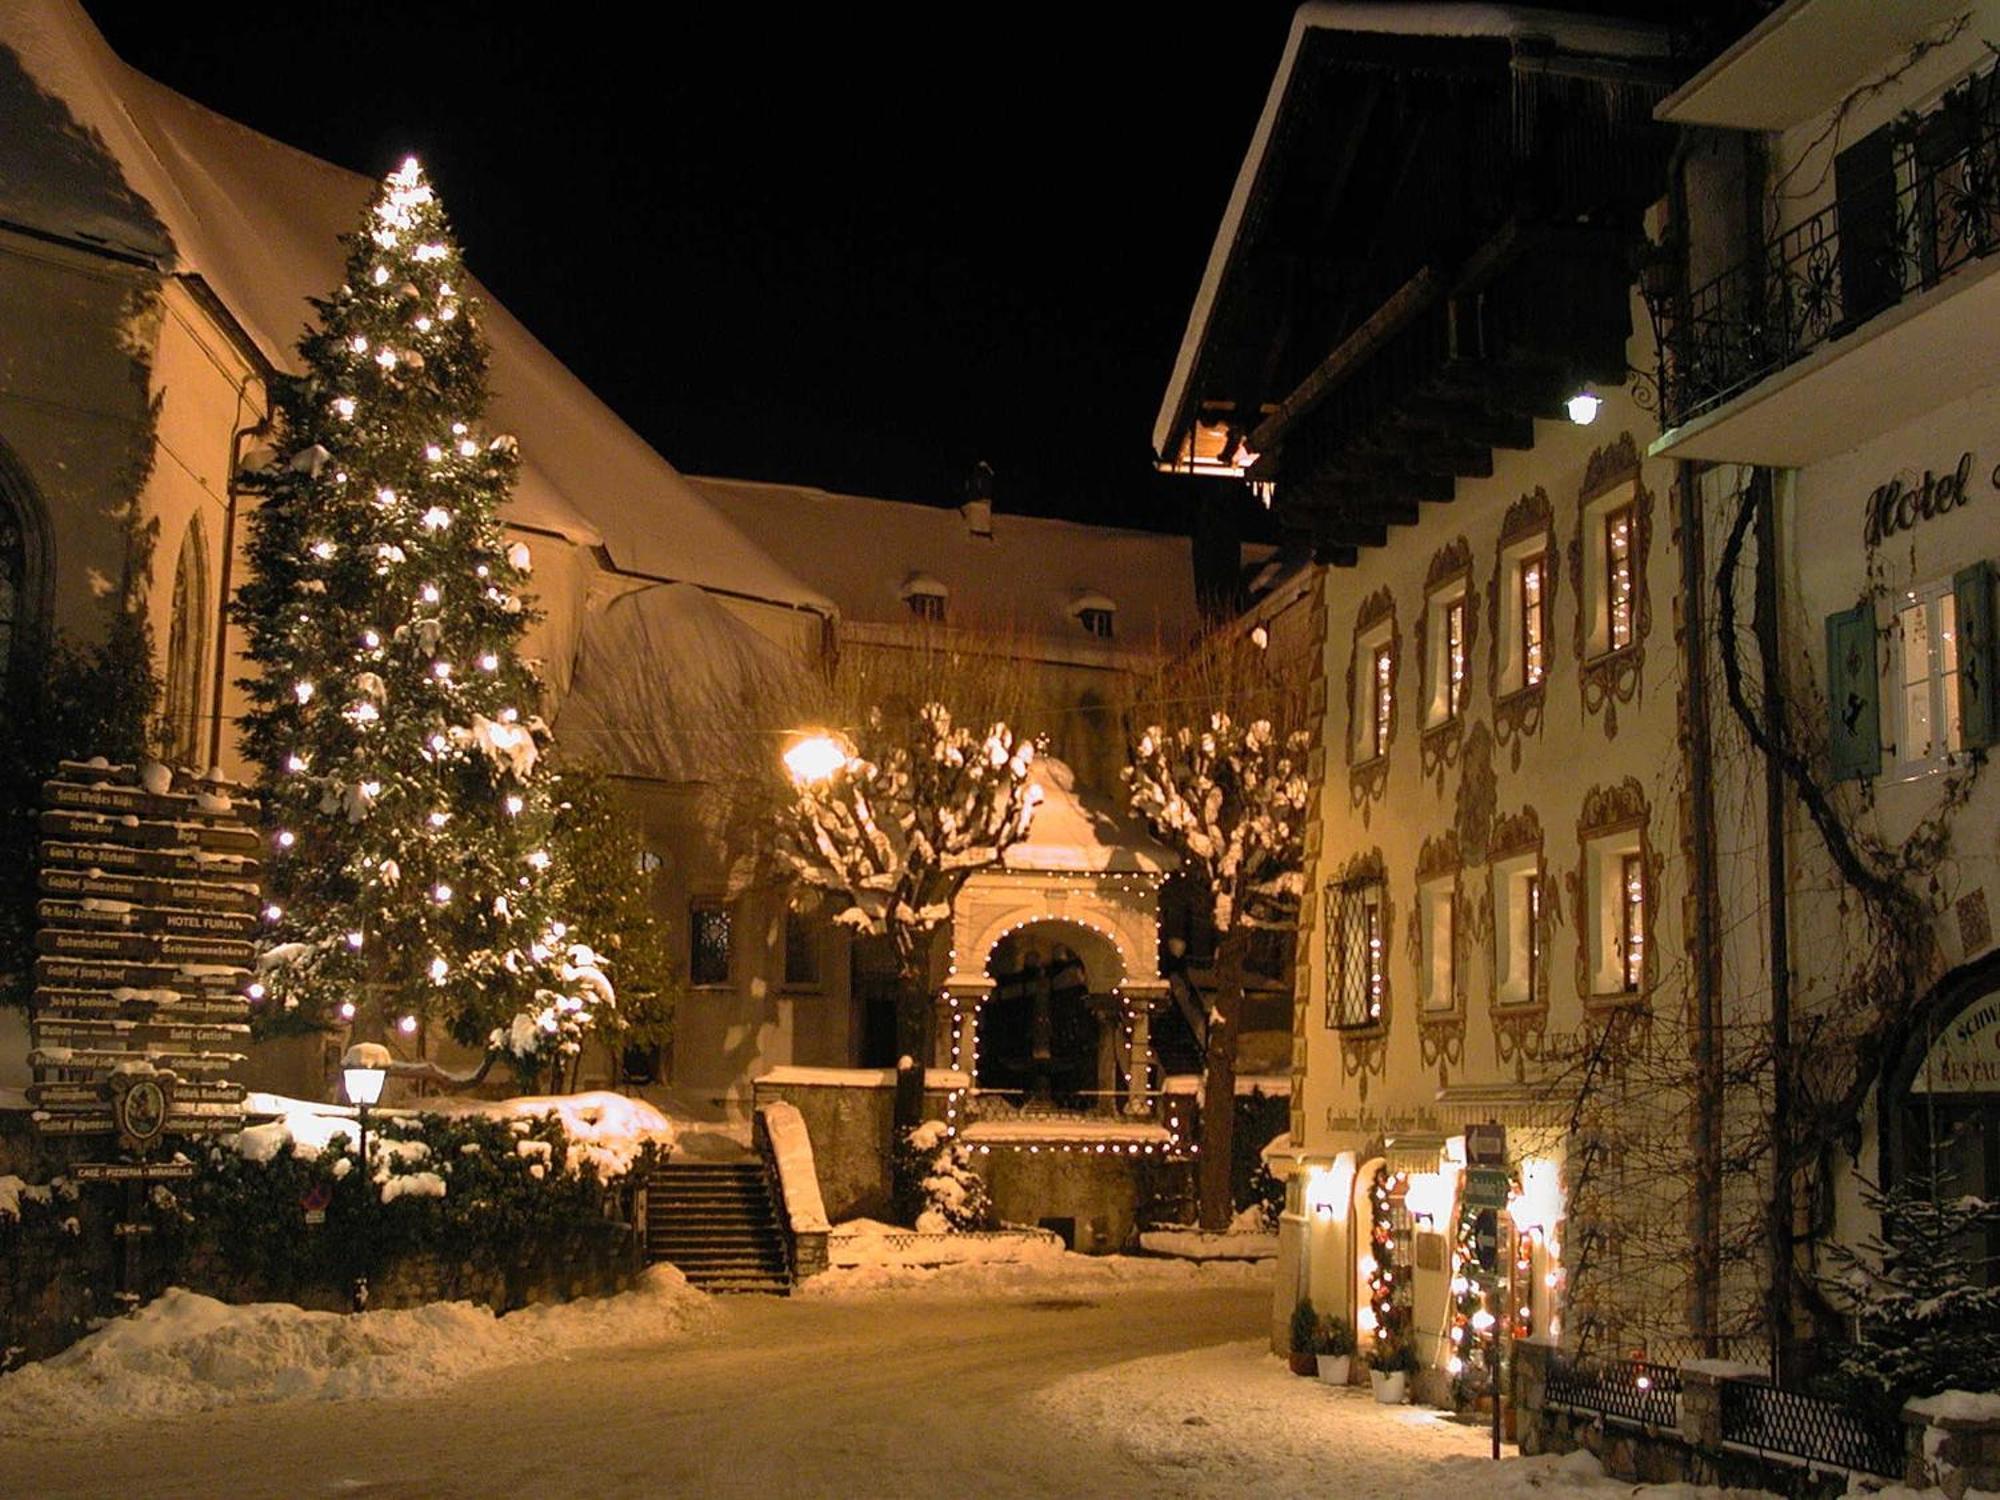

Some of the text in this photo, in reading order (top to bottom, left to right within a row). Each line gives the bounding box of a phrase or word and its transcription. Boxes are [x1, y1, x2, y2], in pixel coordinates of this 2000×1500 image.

[1864, 451, 1968, 549] Hotel
[167, 916, 202, 929] HOTEL
[106, 1168, 142, 1178] PIZZERIA
